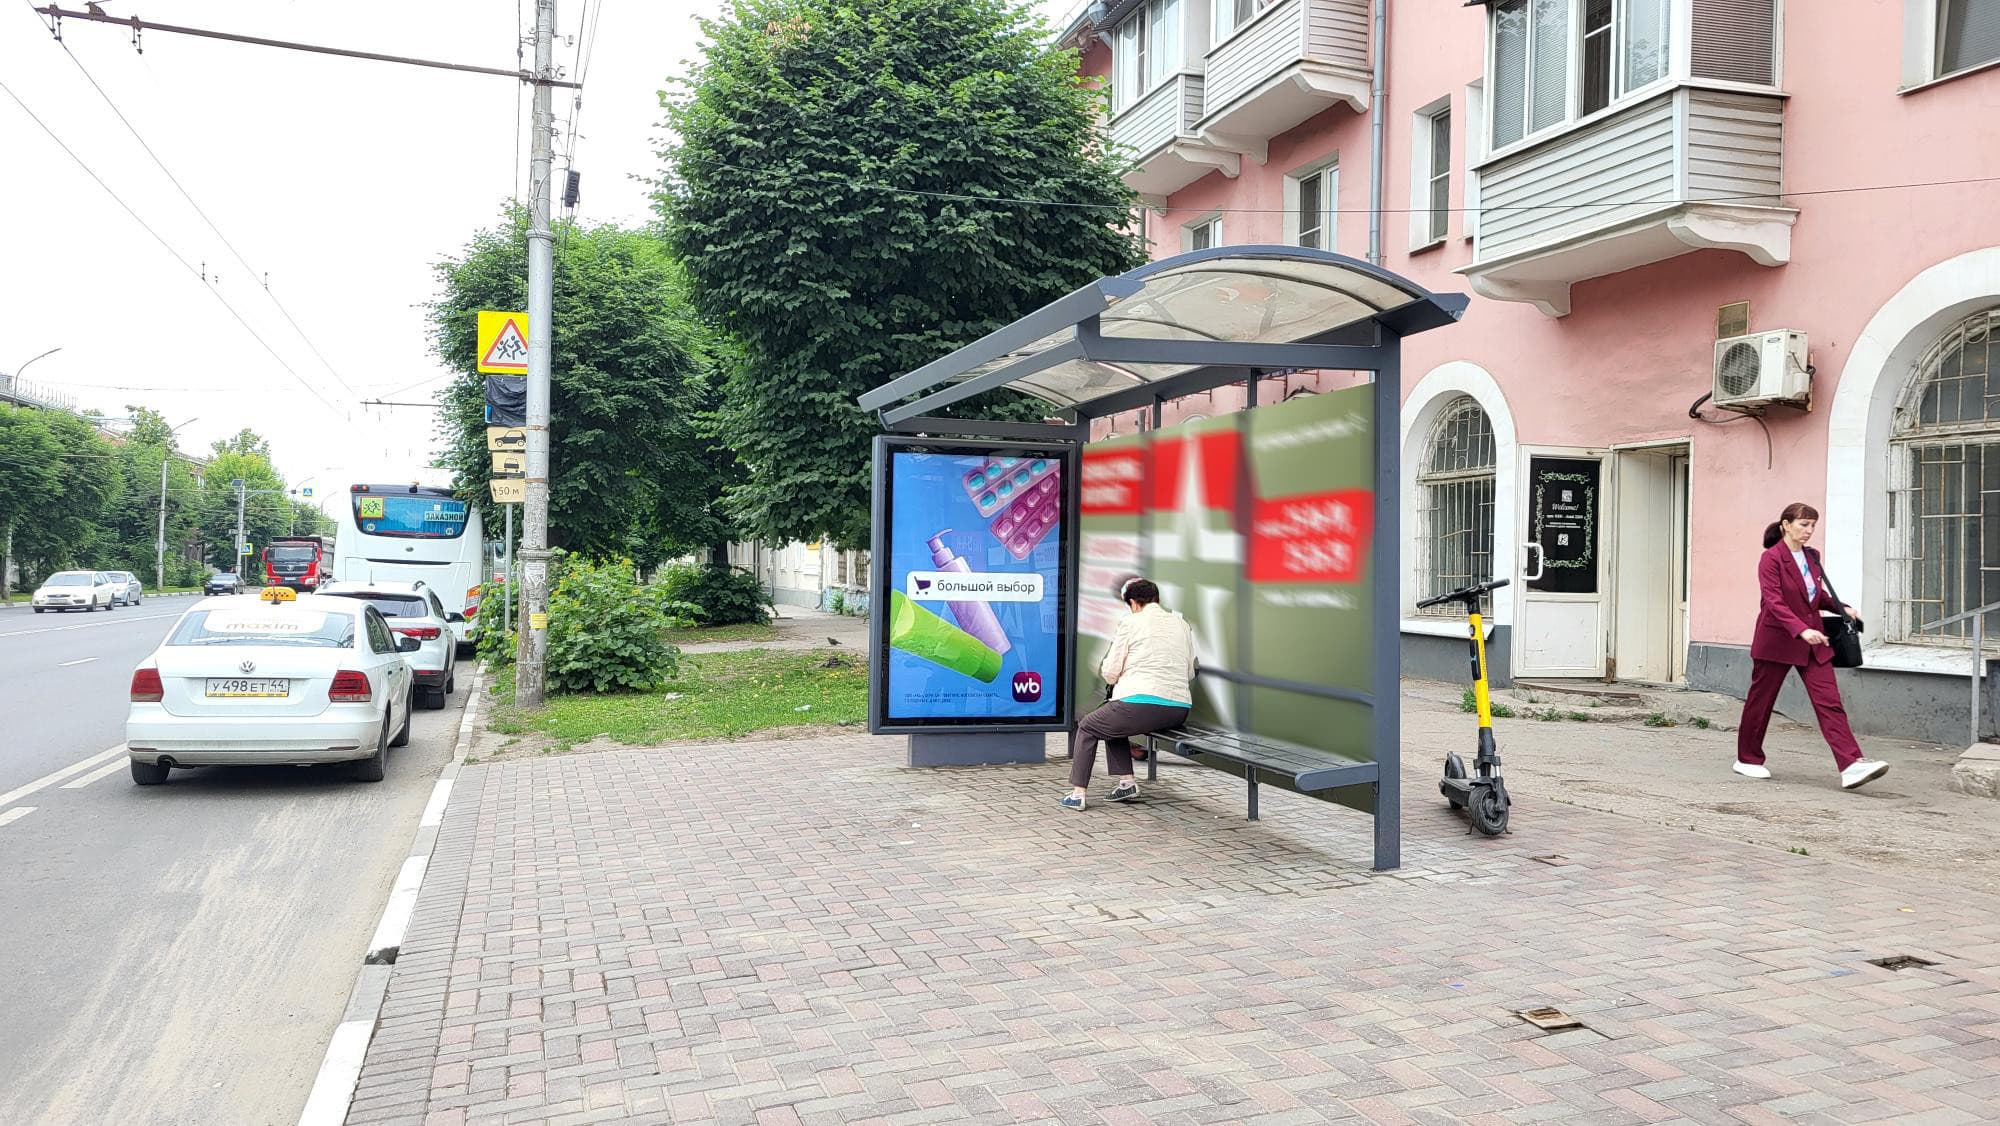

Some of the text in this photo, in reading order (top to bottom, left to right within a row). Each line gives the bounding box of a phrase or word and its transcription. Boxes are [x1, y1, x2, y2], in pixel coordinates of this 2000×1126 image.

[498, 486, 510, 496] 50
[425, 512, 464, 521] ЗАКАЗНОЙ
[937, 579, 1036, 595] большой выбор
[1013, 677, 1041, 694] wb
